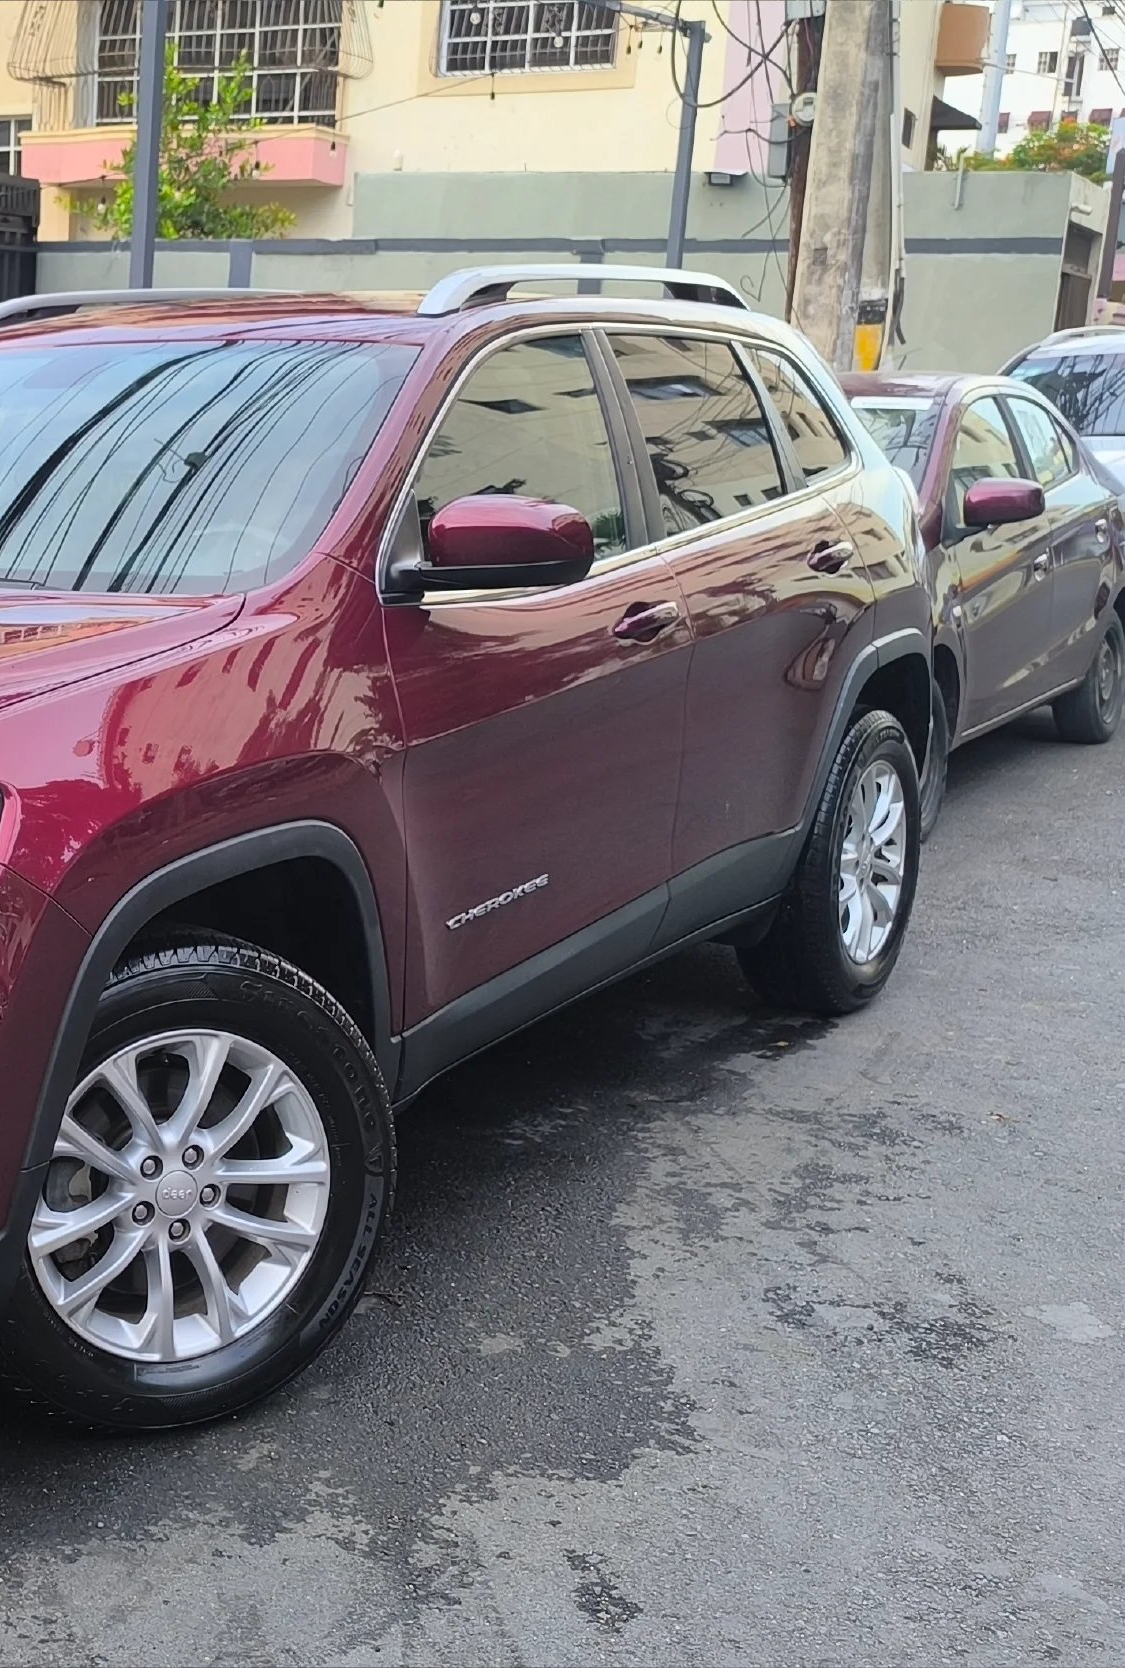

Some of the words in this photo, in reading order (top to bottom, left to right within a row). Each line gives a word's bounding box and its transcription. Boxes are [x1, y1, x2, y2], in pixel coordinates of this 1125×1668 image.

[445, 873, 549, 930] CHEROKEE
[362, 1192, 378, 1237] ALL
[318, 1243, 367, 1330] SEASON
